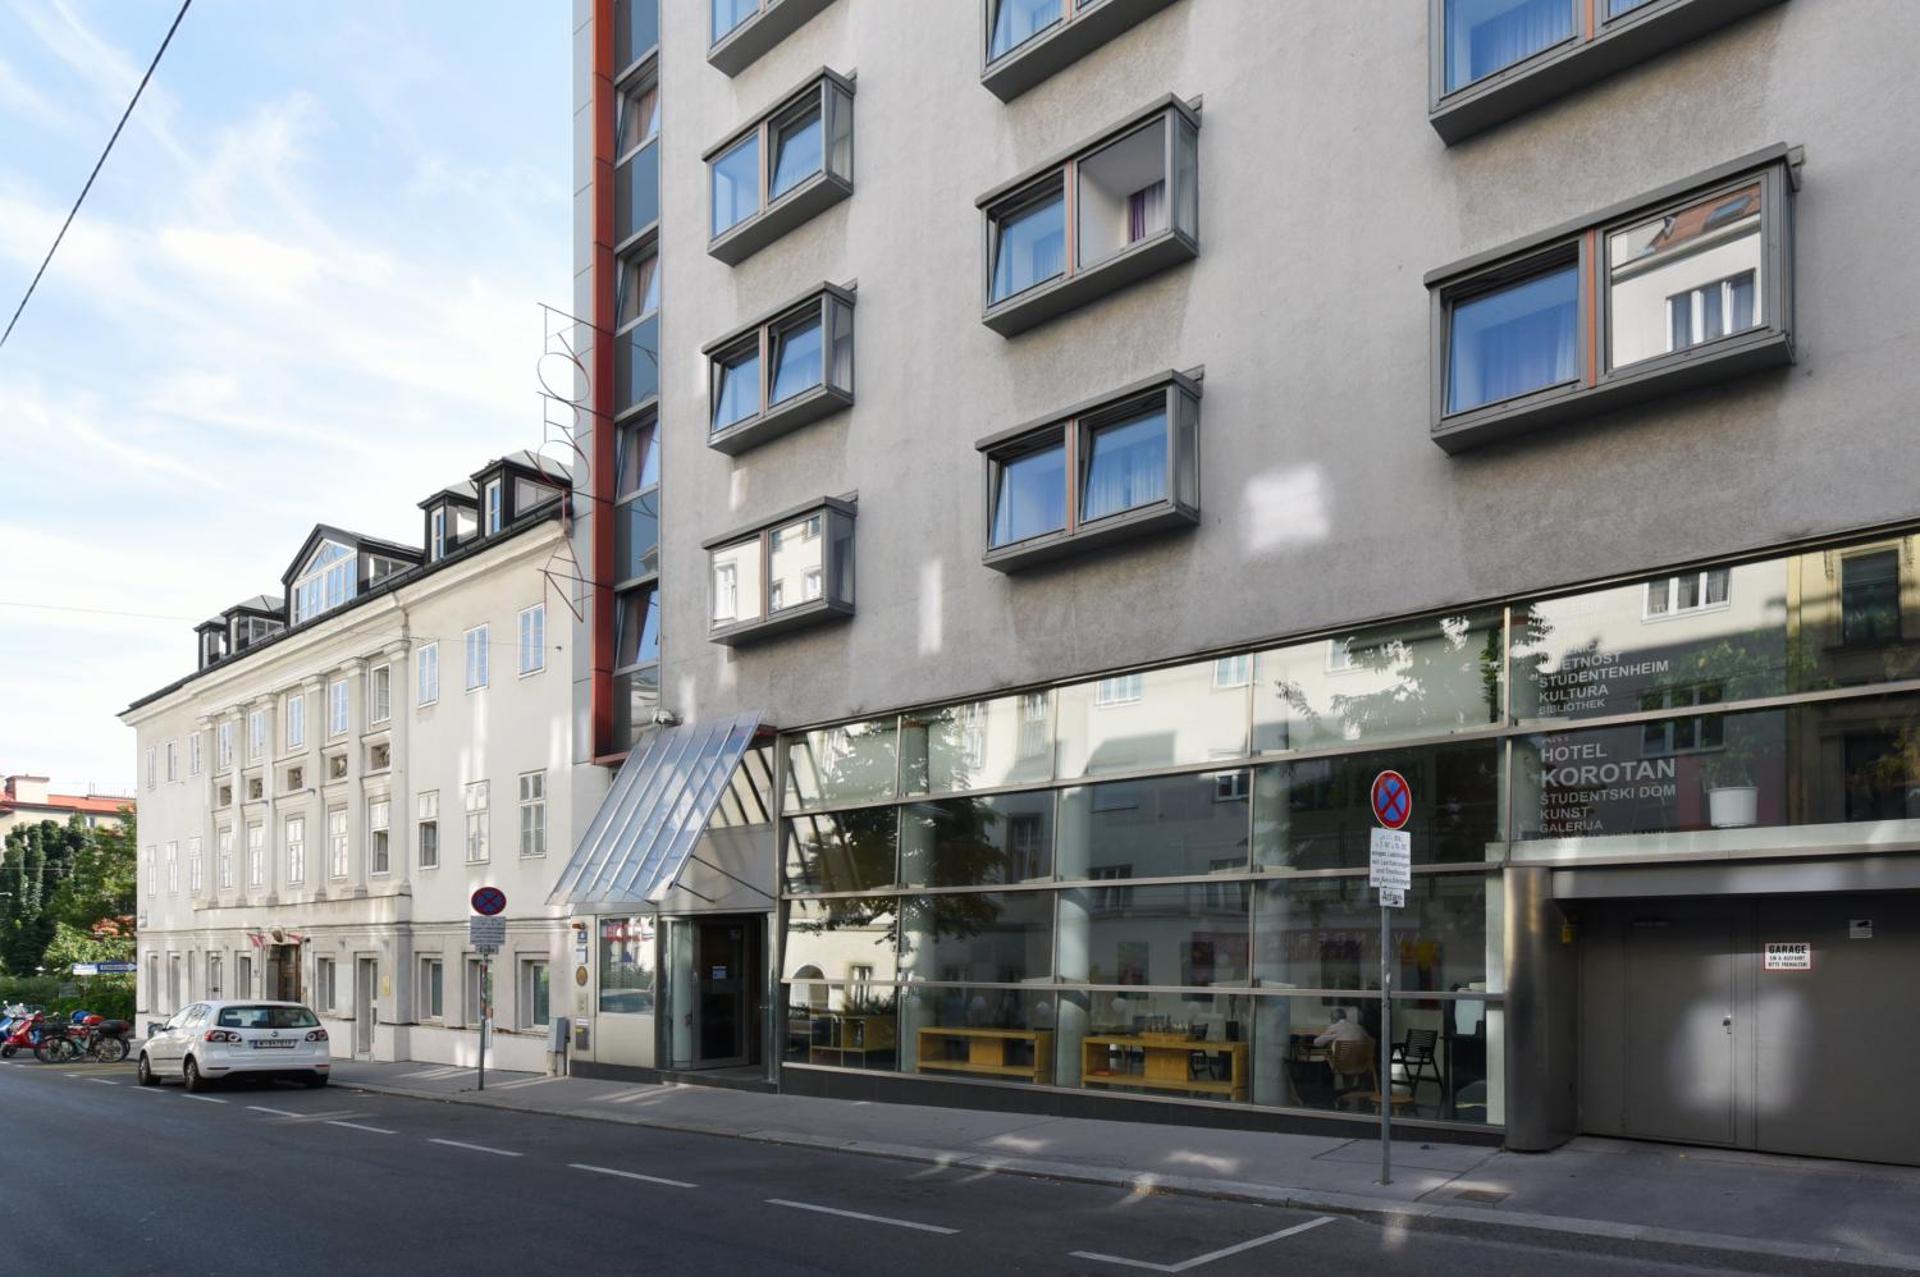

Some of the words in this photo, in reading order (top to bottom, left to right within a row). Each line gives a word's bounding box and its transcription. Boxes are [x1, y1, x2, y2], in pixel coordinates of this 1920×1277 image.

[1538, 660, 1670, 689] STUDENTENHEIM
[1538, 684, 1609, 703] KULTURA
[1537, 698, 1606, 716] BIBLIOTHEK
[1540, 743, 1608, 763] HOTEL
[1541, 758, 1676, 789] KOROTAN
[1639, 784, 1676, 798] DOM
[1539, 806, 1591, 820] KUNST
[1539, 819, 1604, 834] GALERIJA
[1768, 945, 1807, 954] GARAGE
